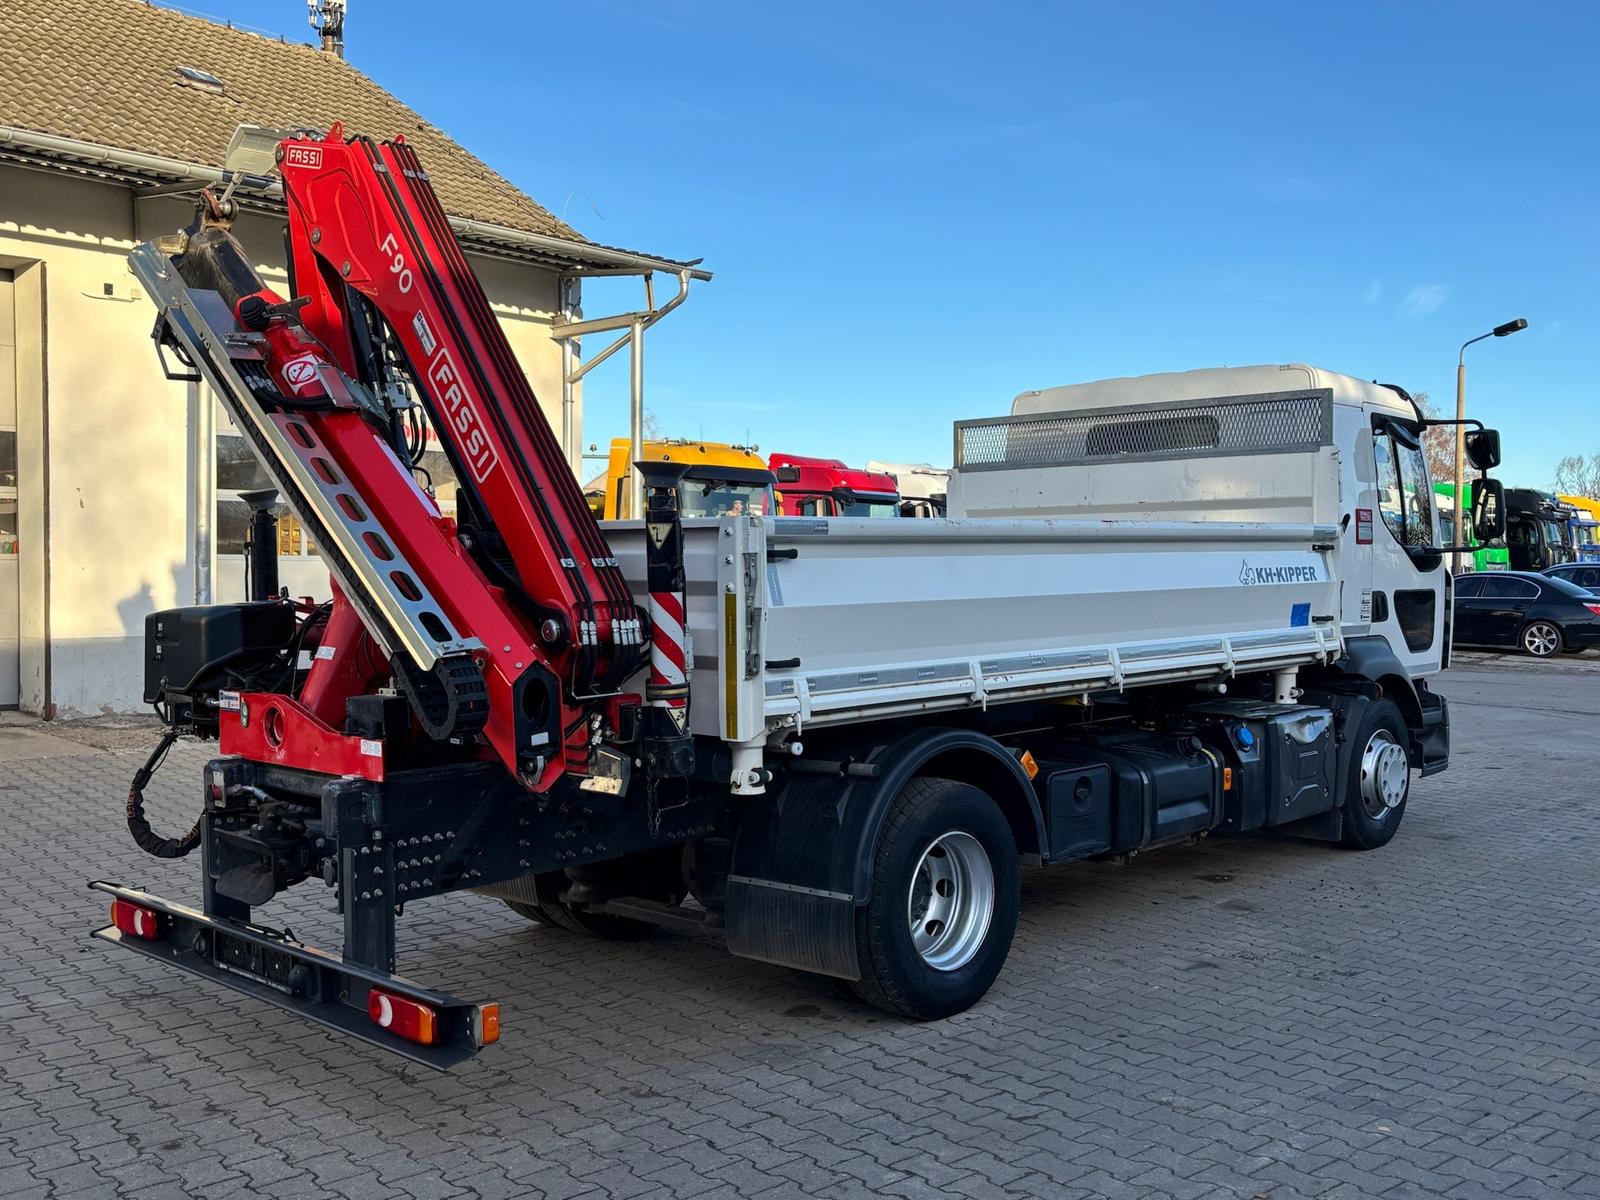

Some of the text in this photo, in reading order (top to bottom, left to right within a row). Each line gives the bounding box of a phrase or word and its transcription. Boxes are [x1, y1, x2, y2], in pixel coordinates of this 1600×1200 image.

[290, 149, 320, 165] FASSI
[381, 233, 412, 293] F90
[436, 364, 489, 468] FASSI
